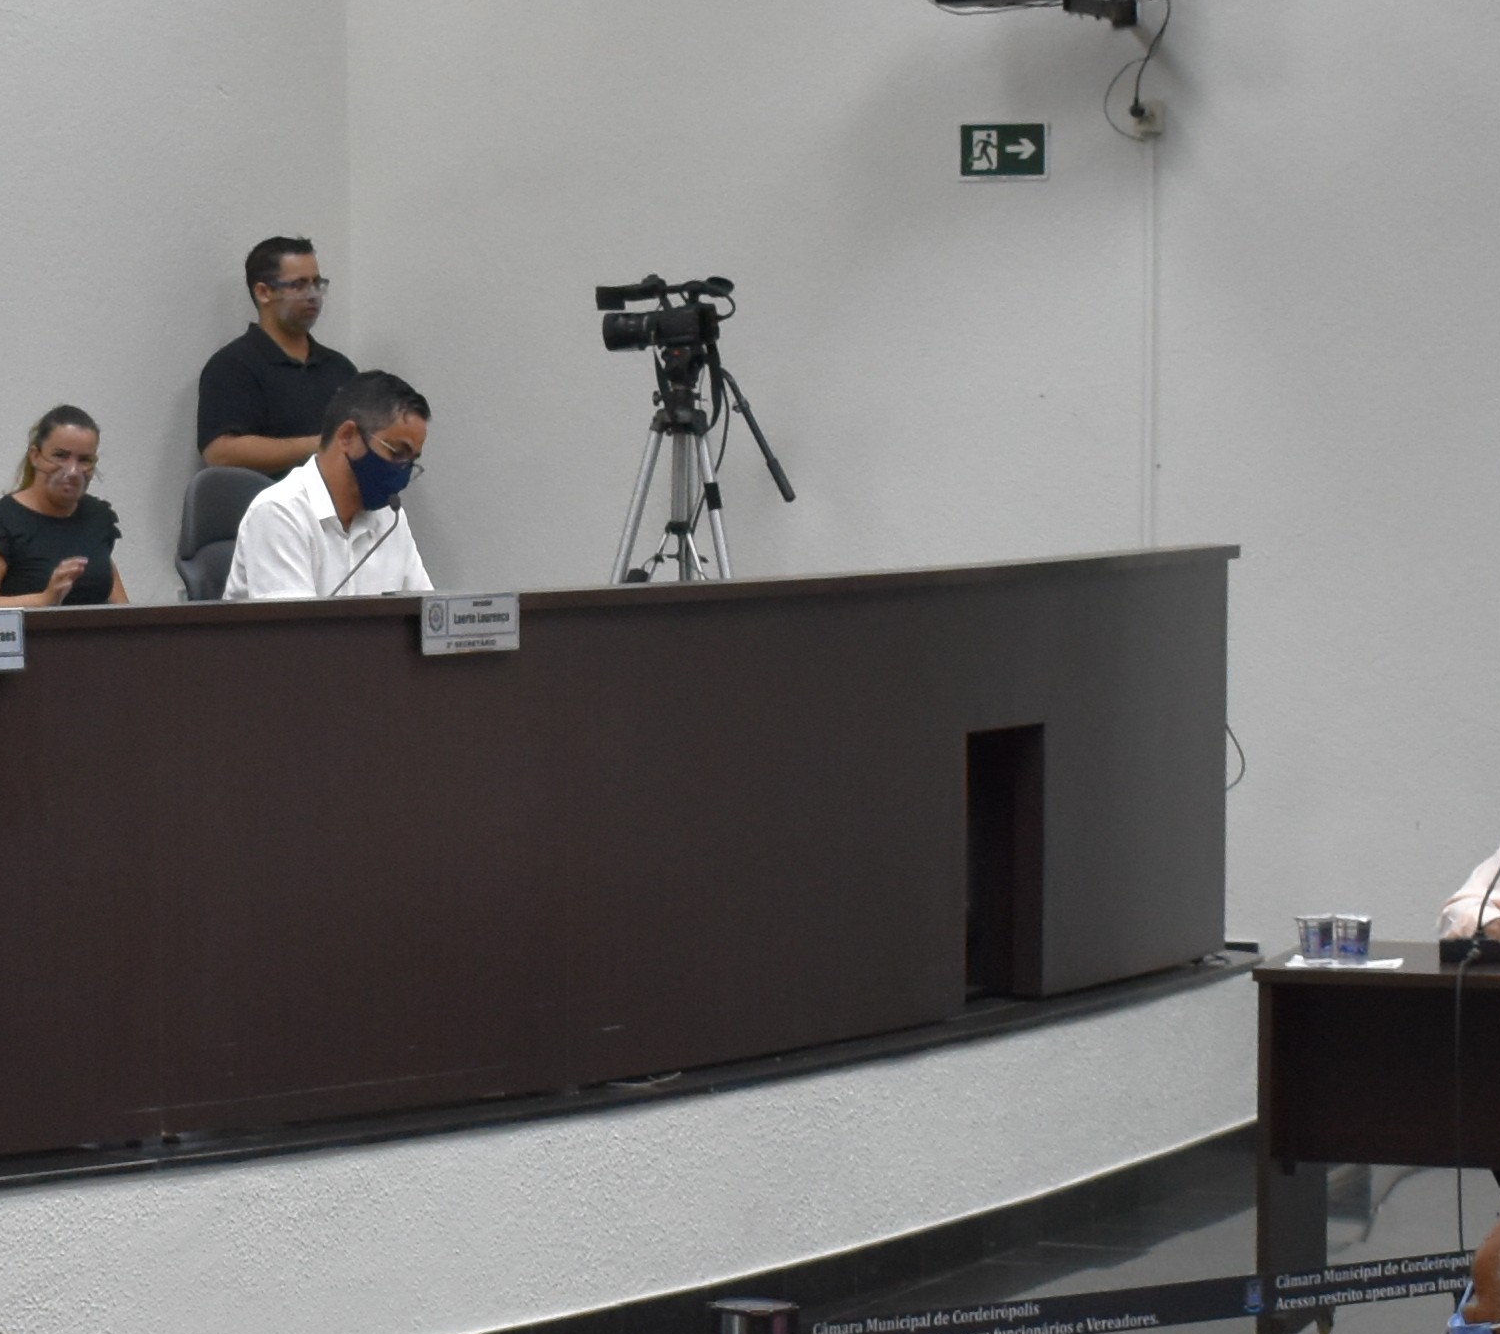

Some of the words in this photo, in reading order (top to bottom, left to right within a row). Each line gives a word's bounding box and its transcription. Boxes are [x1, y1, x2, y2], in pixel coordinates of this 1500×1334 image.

[1276, 1272, 1321, 1289] Câmara
[1324, 1264, 1382, 1283] Municipal
[1385, 1261, 1399, 1275] de
[1275, 1296, 1316, 1311] Acesso
[1318, 1286, 1363, 1306] restrito
[1365, 1283, 1407, 1303] apenas
[1409, 1279, 1435, 1298] para
[865, 1312, 931, 1333] Municipal
[933, 1310, 950, 1327] de
[952, 1301, 1040, 1325] Cordeirópolis
[1075, 1321, 1084, 1334] e
[1086, 1312, 1160, 1333] Vereadores.
